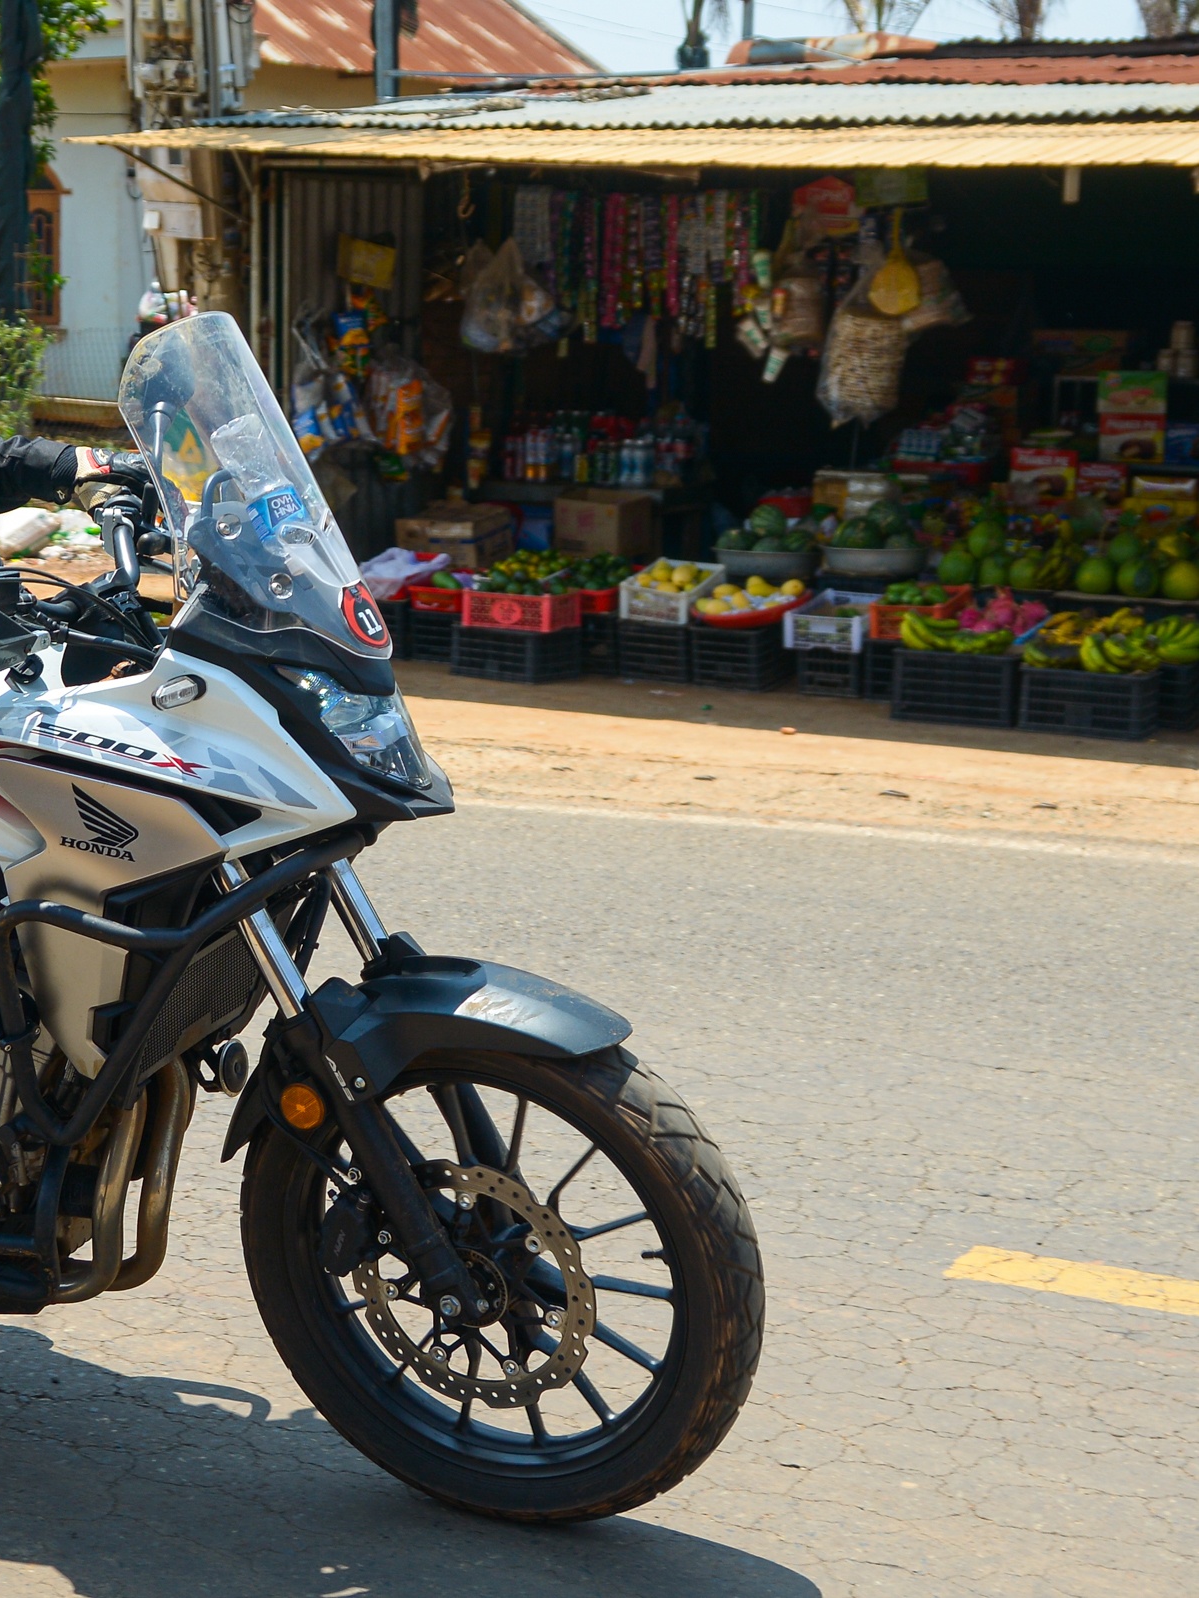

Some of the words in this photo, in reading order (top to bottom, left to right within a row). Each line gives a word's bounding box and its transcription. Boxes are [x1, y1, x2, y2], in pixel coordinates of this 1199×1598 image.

[358, 608, 382, 636] 11
[30, 722, 211, 780] 500X
[59, 836, 136, 863] HONDA
